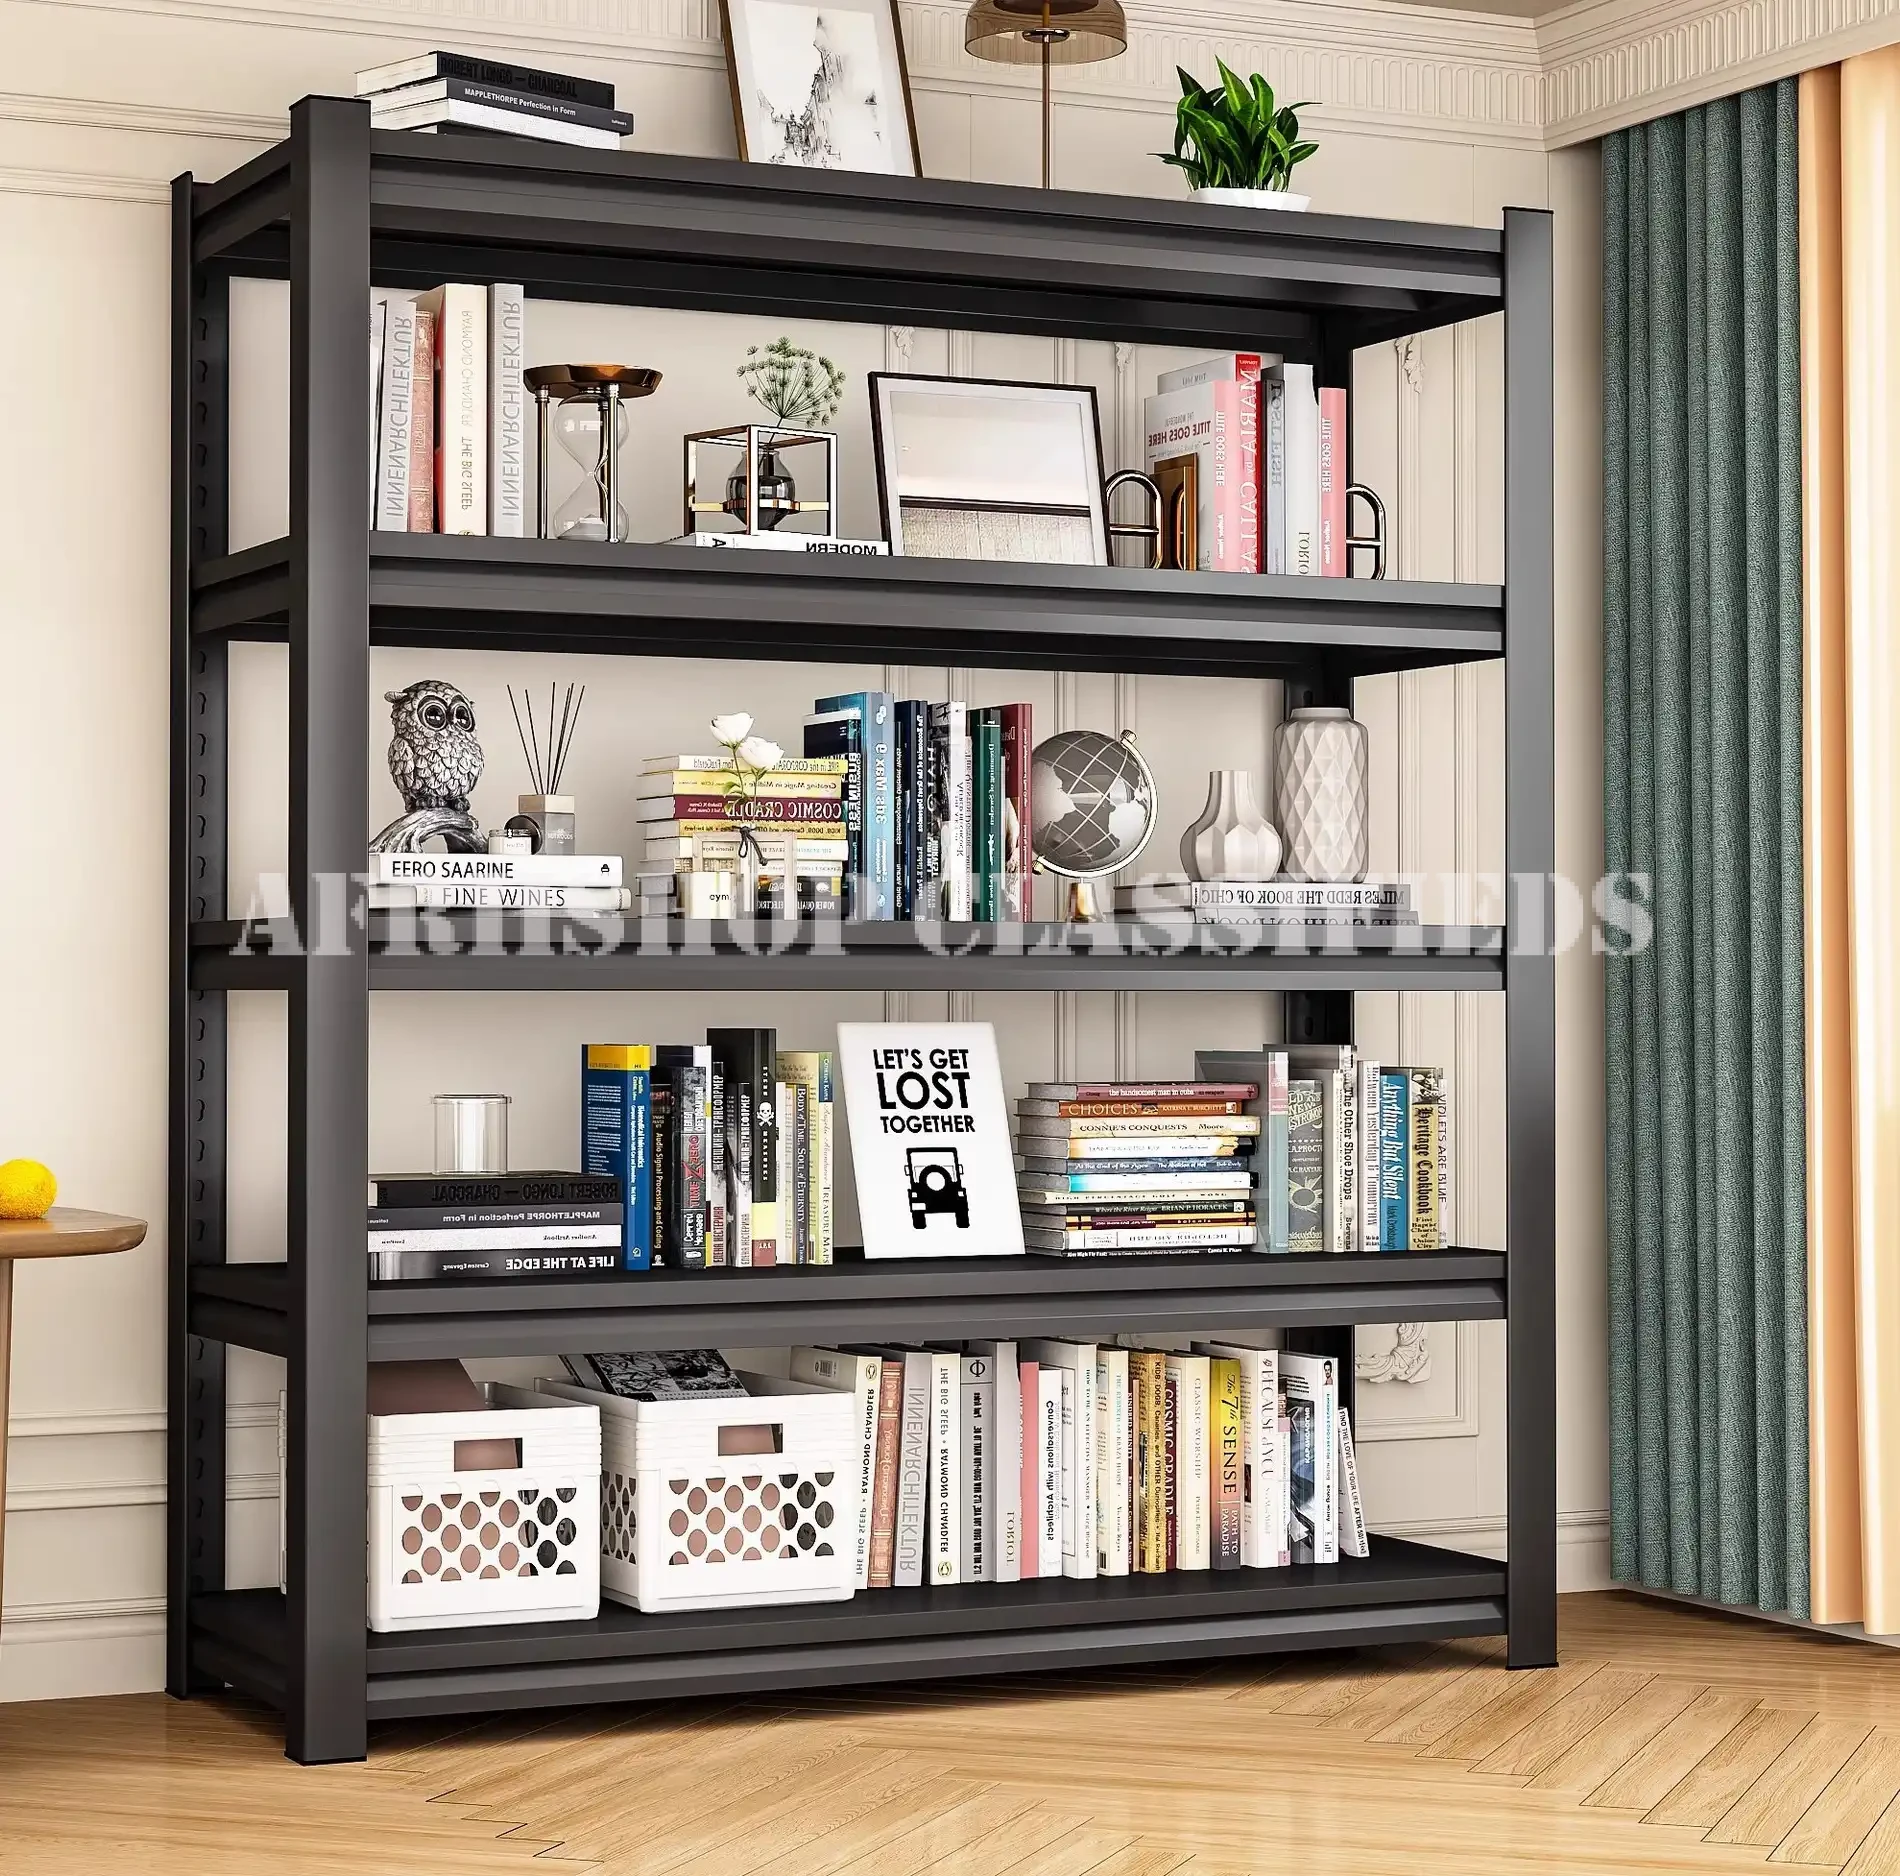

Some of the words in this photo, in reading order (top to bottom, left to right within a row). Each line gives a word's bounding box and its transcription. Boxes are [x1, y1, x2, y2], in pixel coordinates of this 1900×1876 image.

[464, 88, 518, 105] MAPPLETHORPE
[519, 100, 551, 112] Perfection
[559, 106, 577, 116] Form
[392, 861, 436, 878] EERO
[442, 861, 514, 879] SAARINE
[444, 888, 488, 906] FINE
[498, 888, 566, 907] WINES
[873, 1048, 924, 1070] LET'S
[930, 1048, 969, 1070] GET
[796, 1088, 806, 1112] BODY
[876, 1070, 971, 1110] LOST
[1109, 1089, 1120, 1097] the
[1344, 1087, 1353, 1108] The
[1068, 1103, 1138, 1116] CHOICES
[1381, 1082, 1404, 1137] Anything
[1438, 1094, 1447, 1141] VIOLETS
[796, 1120, 806, 1146] TIME,
[880, 1115, 976, 1134] TOGETHER
[1080, 1123, 1127, 1132] CONNIE'S
[1128, 1122, 1188, 1132] CONQUESTS
[1344, 1110, 1353, 1139] Other
[1412, 1107, 1434, 1157] Heritage
[655, 1132, 664, 1152] Audio
[1383, 1141, 1404, 1163] But
[653, 1153, 664, 1174] Signal
[796, 1148, 806, 1171] SOUL
[1344, 1142, 1353, 1167] Shoe
[1438, 1145, 1447, 1170] ARE
[653, 1175, 664, 1211] Processing
[1342, 1169, 1353, 1201] Drops
[1382, 1164, 1404, 1201] Silent
[1413, 1160, 1433, 1215] Cookbook
[796, 1181, 806, 1222] ETERNITY
[822, 1186, 831, 1234] TREASURE
[655, 1211, 664, 1220] and
[653, 1220, 664, 1249] Coding
[822, 1236, 831, 1264] MAPS
[1226, 1373, 1237, 1394] The
[1194, 1378, 1202, 1425] CLASSIC
[1220, 1395, 1239, 1420] 7th
[1338, 1411, 1348, 1427] FIND
[1341, 1428, 1350, 1441] THE
[1194, 1427, 1202, 1479] WORSHIP
[1222, 1425, 1237, 1494] SENSE
[1343, 1442, 1353, 1461] LOVE
[1153, 1460, 1161, 1484] OTHER
[1345, 1461, 1354, 1470] OF
[1347, 1471, 1357, 1490] YOUR
[1350, 1491, 1360, 1506] LIFE
[1230, 1510, 1238, 1536] PATH
[1353, 1507, 1363, 1529] AFTER
[1221, 1508, 1230, 1556] PARADISE
[1230, 1541, 1238, 1554] TO
